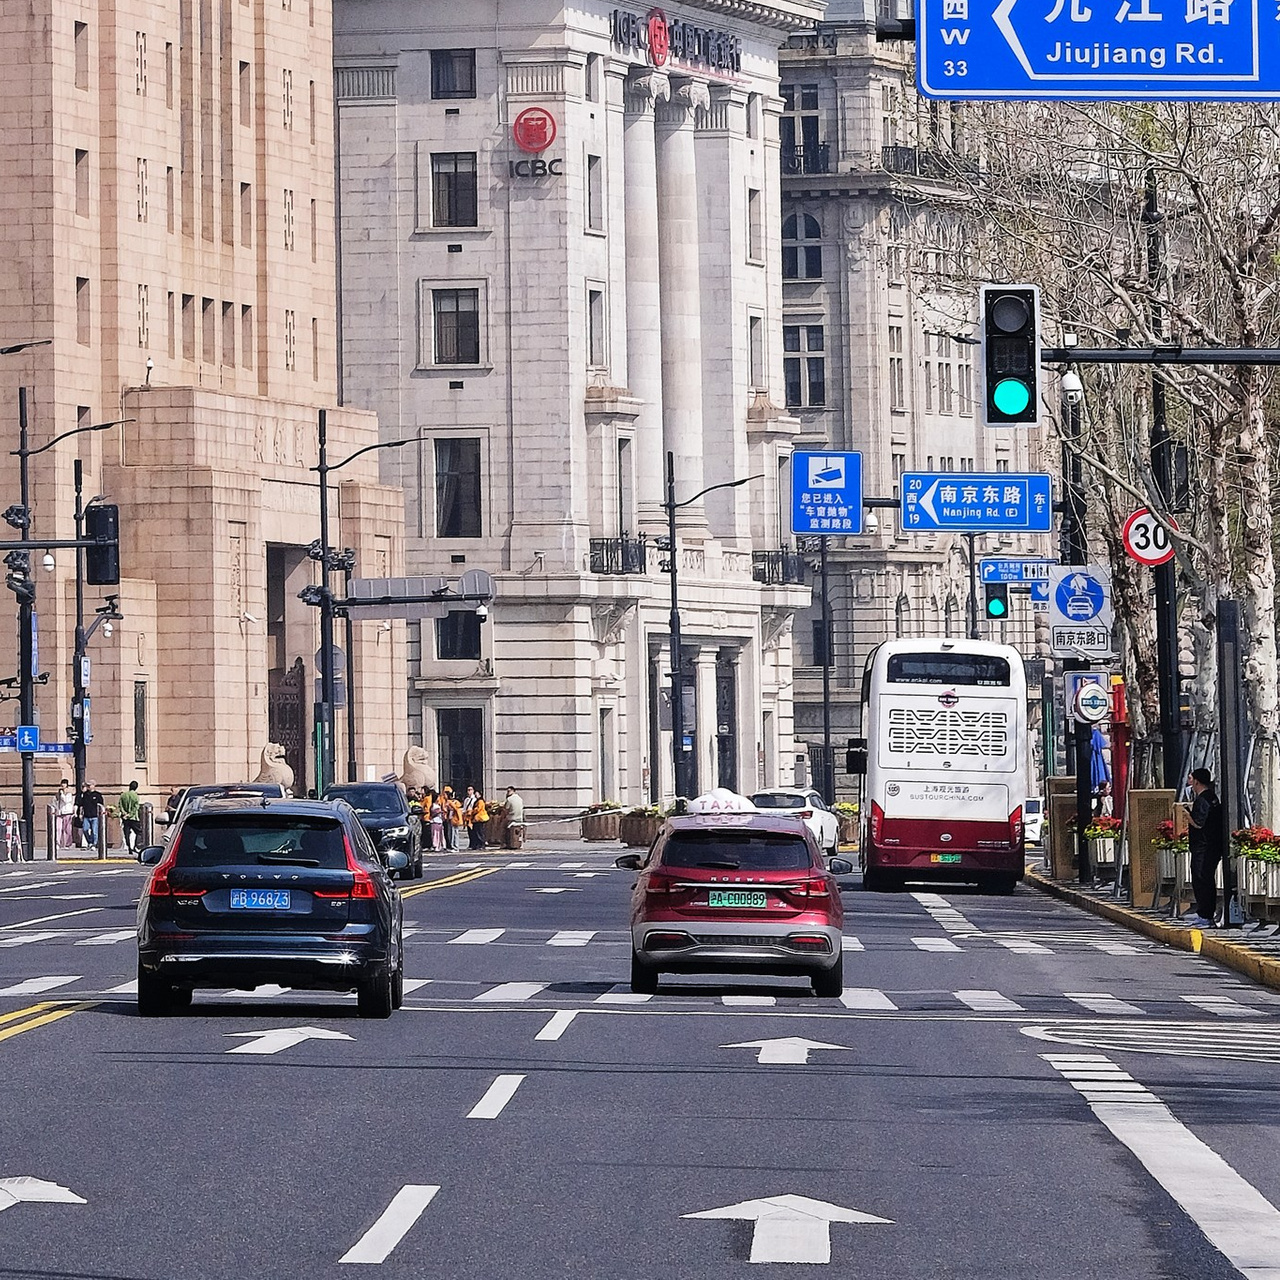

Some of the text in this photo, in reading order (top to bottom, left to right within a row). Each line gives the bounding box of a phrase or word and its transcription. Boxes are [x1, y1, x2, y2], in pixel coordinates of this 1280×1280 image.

[613, 9, 649, 49] ICBC
[941, 28, 971, 45] W
[1046, 41, 1224, 68] Jiujiang Rd.
[943, 60, 968, 76] 33
[508, 158, 562, 178] ICBC
[909, 479, 922, 490] 20
[801, 493, 843, 504] 您已进入
[906, 492, 917, 504] 西
[940, 485, 1021, 504] 南京东路
[1034, 493, 1046, 504] 东
[943, 507, 1018, 519] Nanjing Rd. (E)
[1036, 505, 1043, 513] E
[909, 514, 920, 524] 19
[1134, 523, 1169, 550] 30
[1056, 630, 1106, 646] 南京东路口
[700, 800, 741, 810] TAXI
